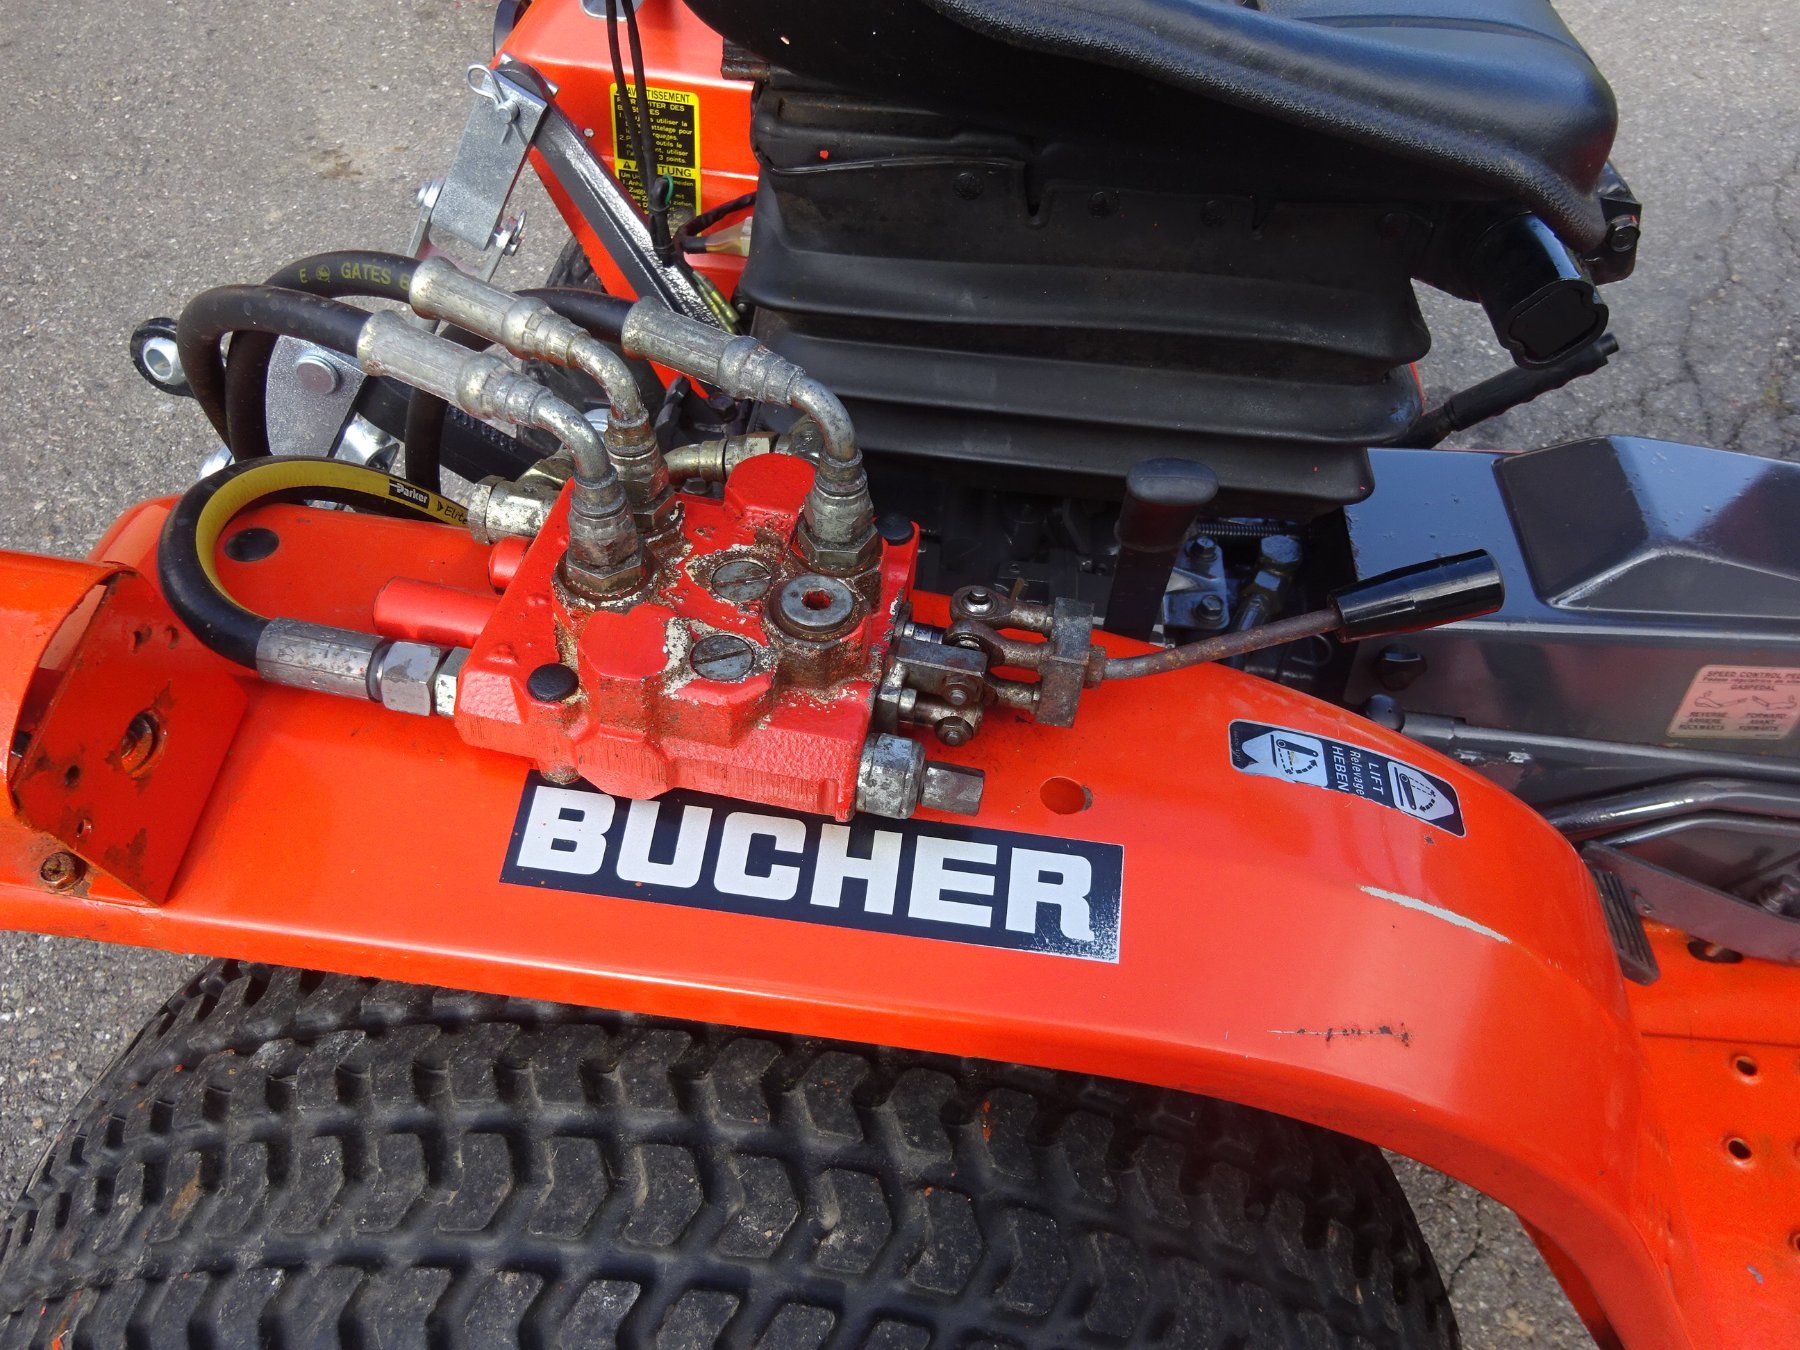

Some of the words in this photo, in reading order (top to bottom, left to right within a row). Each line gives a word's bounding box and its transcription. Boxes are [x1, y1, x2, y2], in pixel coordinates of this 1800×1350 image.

[628, 87, 690, 103] AVTISSEMENT
[670, 104, 685, 112] DES
[341, 262, 392, 285] GATES
[396, 482, 428, 503] Parker
[1739, 671, 1781, 679] CONTROL
[1331, 745, 1350, 791] HEBEN
[1350, 750, 1365, 795] Relevage
[1368, 762, 1384, 795] LIFT
[516, 785, 1095, 942] BUCHER
